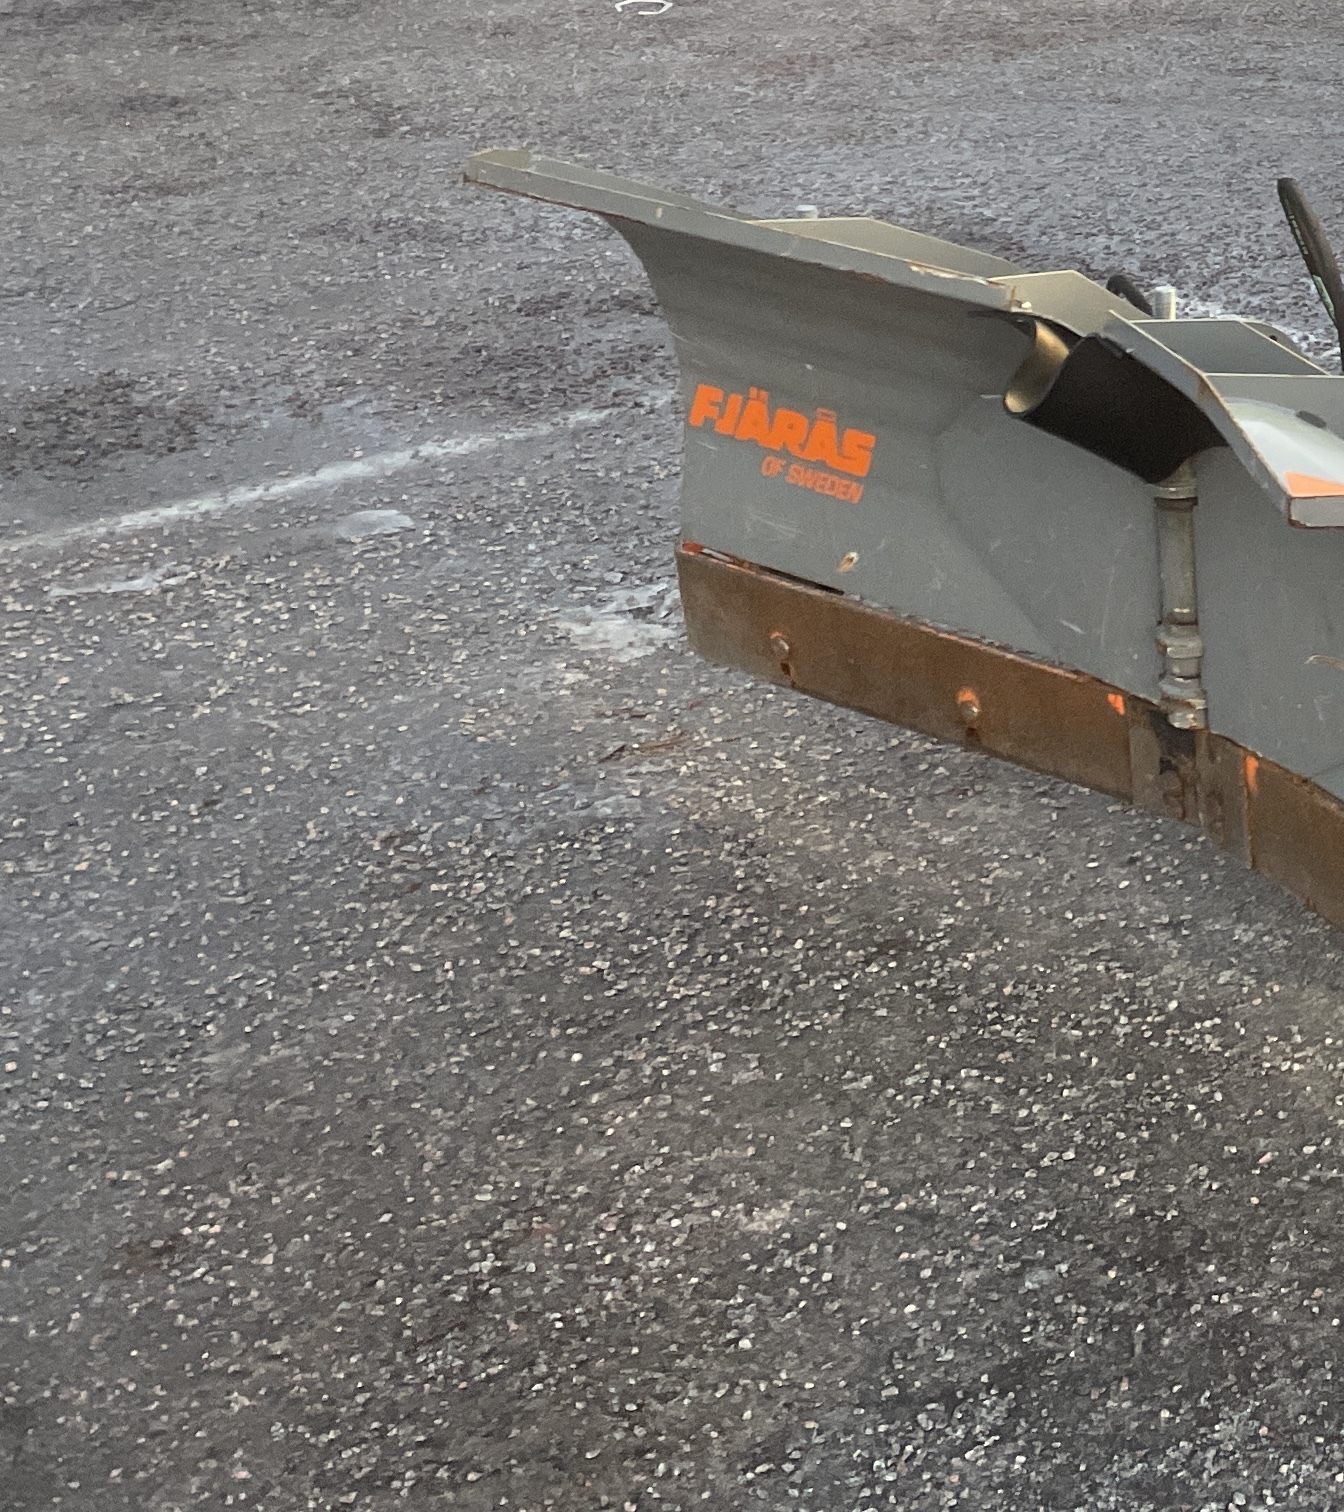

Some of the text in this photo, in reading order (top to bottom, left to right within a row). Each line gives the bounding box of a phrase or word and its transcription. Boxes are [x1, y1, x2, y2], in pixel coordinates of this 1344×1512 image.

[688, 383, 877, 478] FJÄRÅS
[760, 455, 865, 505] OF SWEDEN
